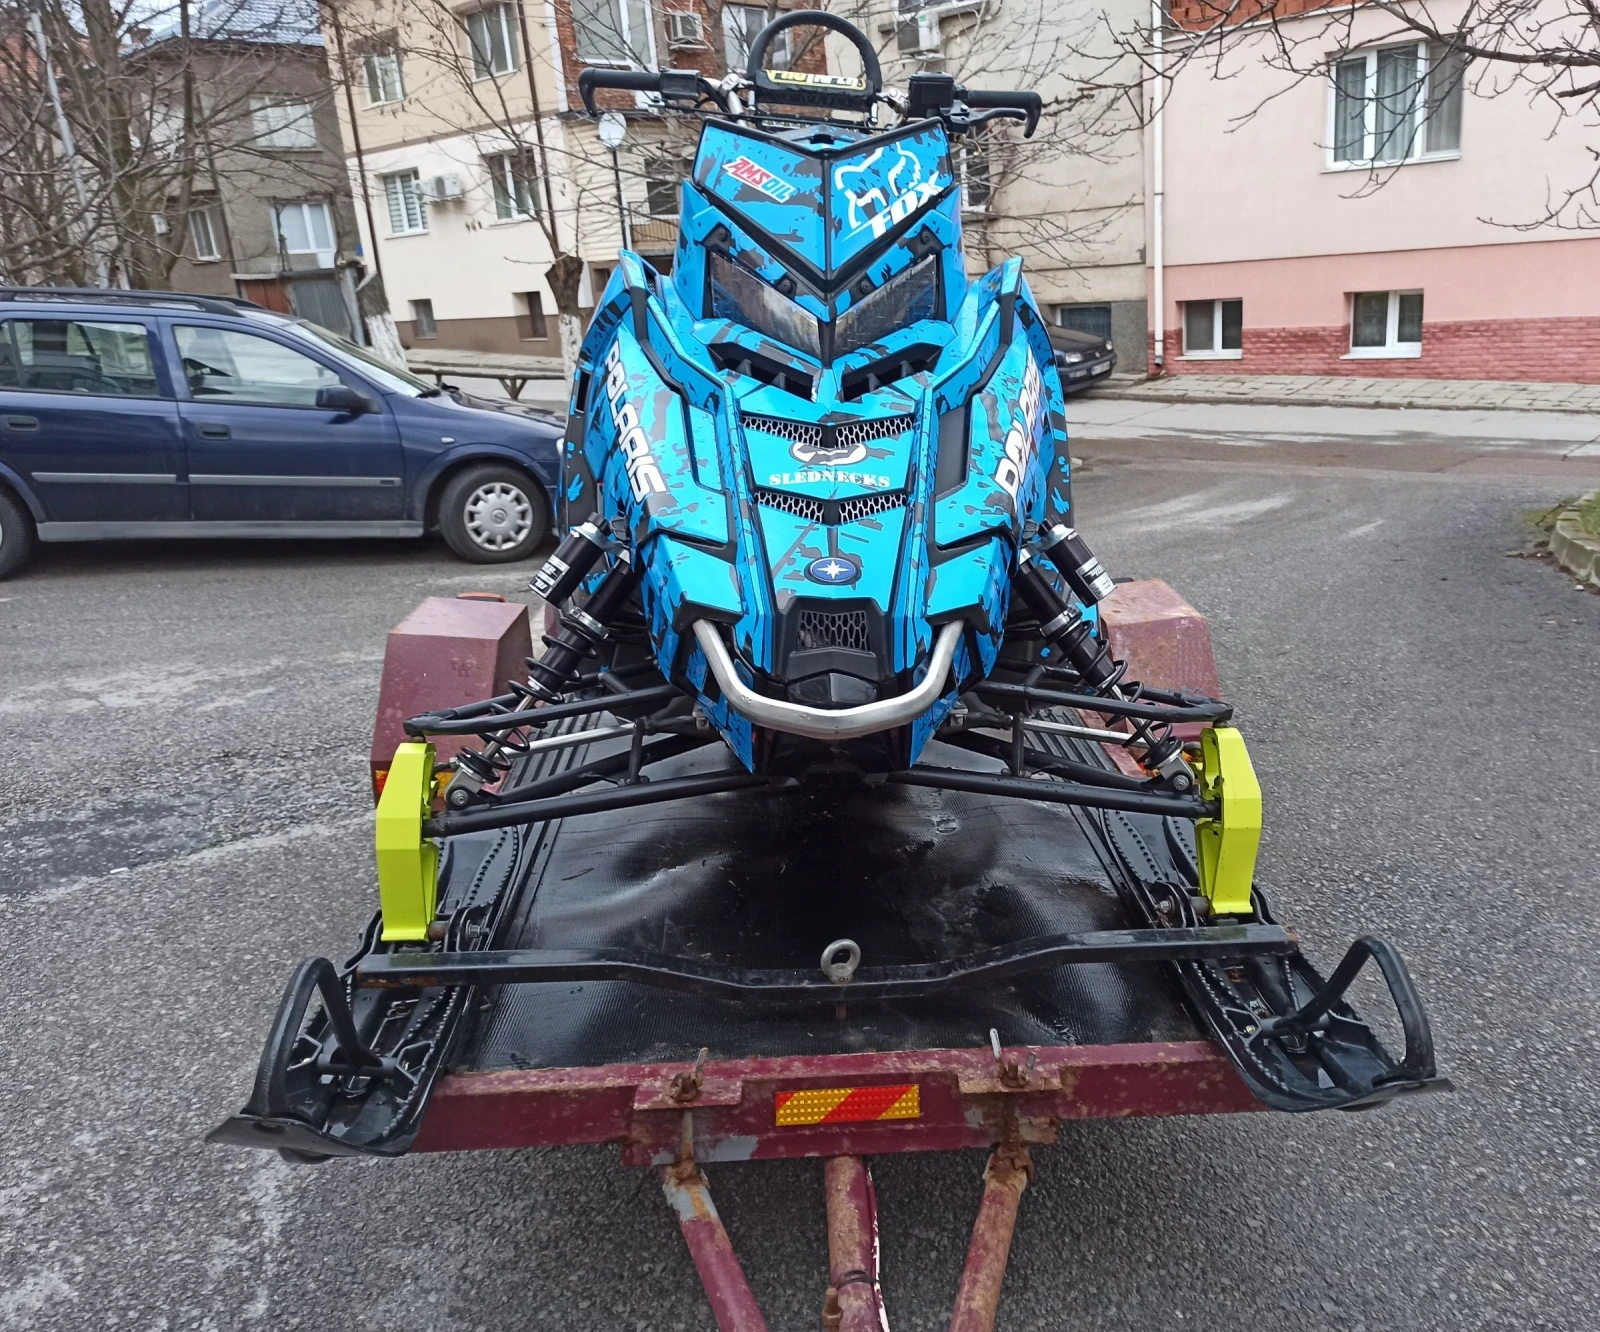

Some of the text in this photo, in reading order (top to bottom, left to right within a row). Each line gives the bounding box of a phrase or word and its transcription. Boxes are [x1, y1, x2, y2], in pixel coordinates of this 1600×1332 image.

[725, 157, 794, 202] AMSOIL
[856, 171, 944, 239] FOX
[605, 340, 667, 503] POLARIS
[769, 470, 890, 488] SLEDNECKS
